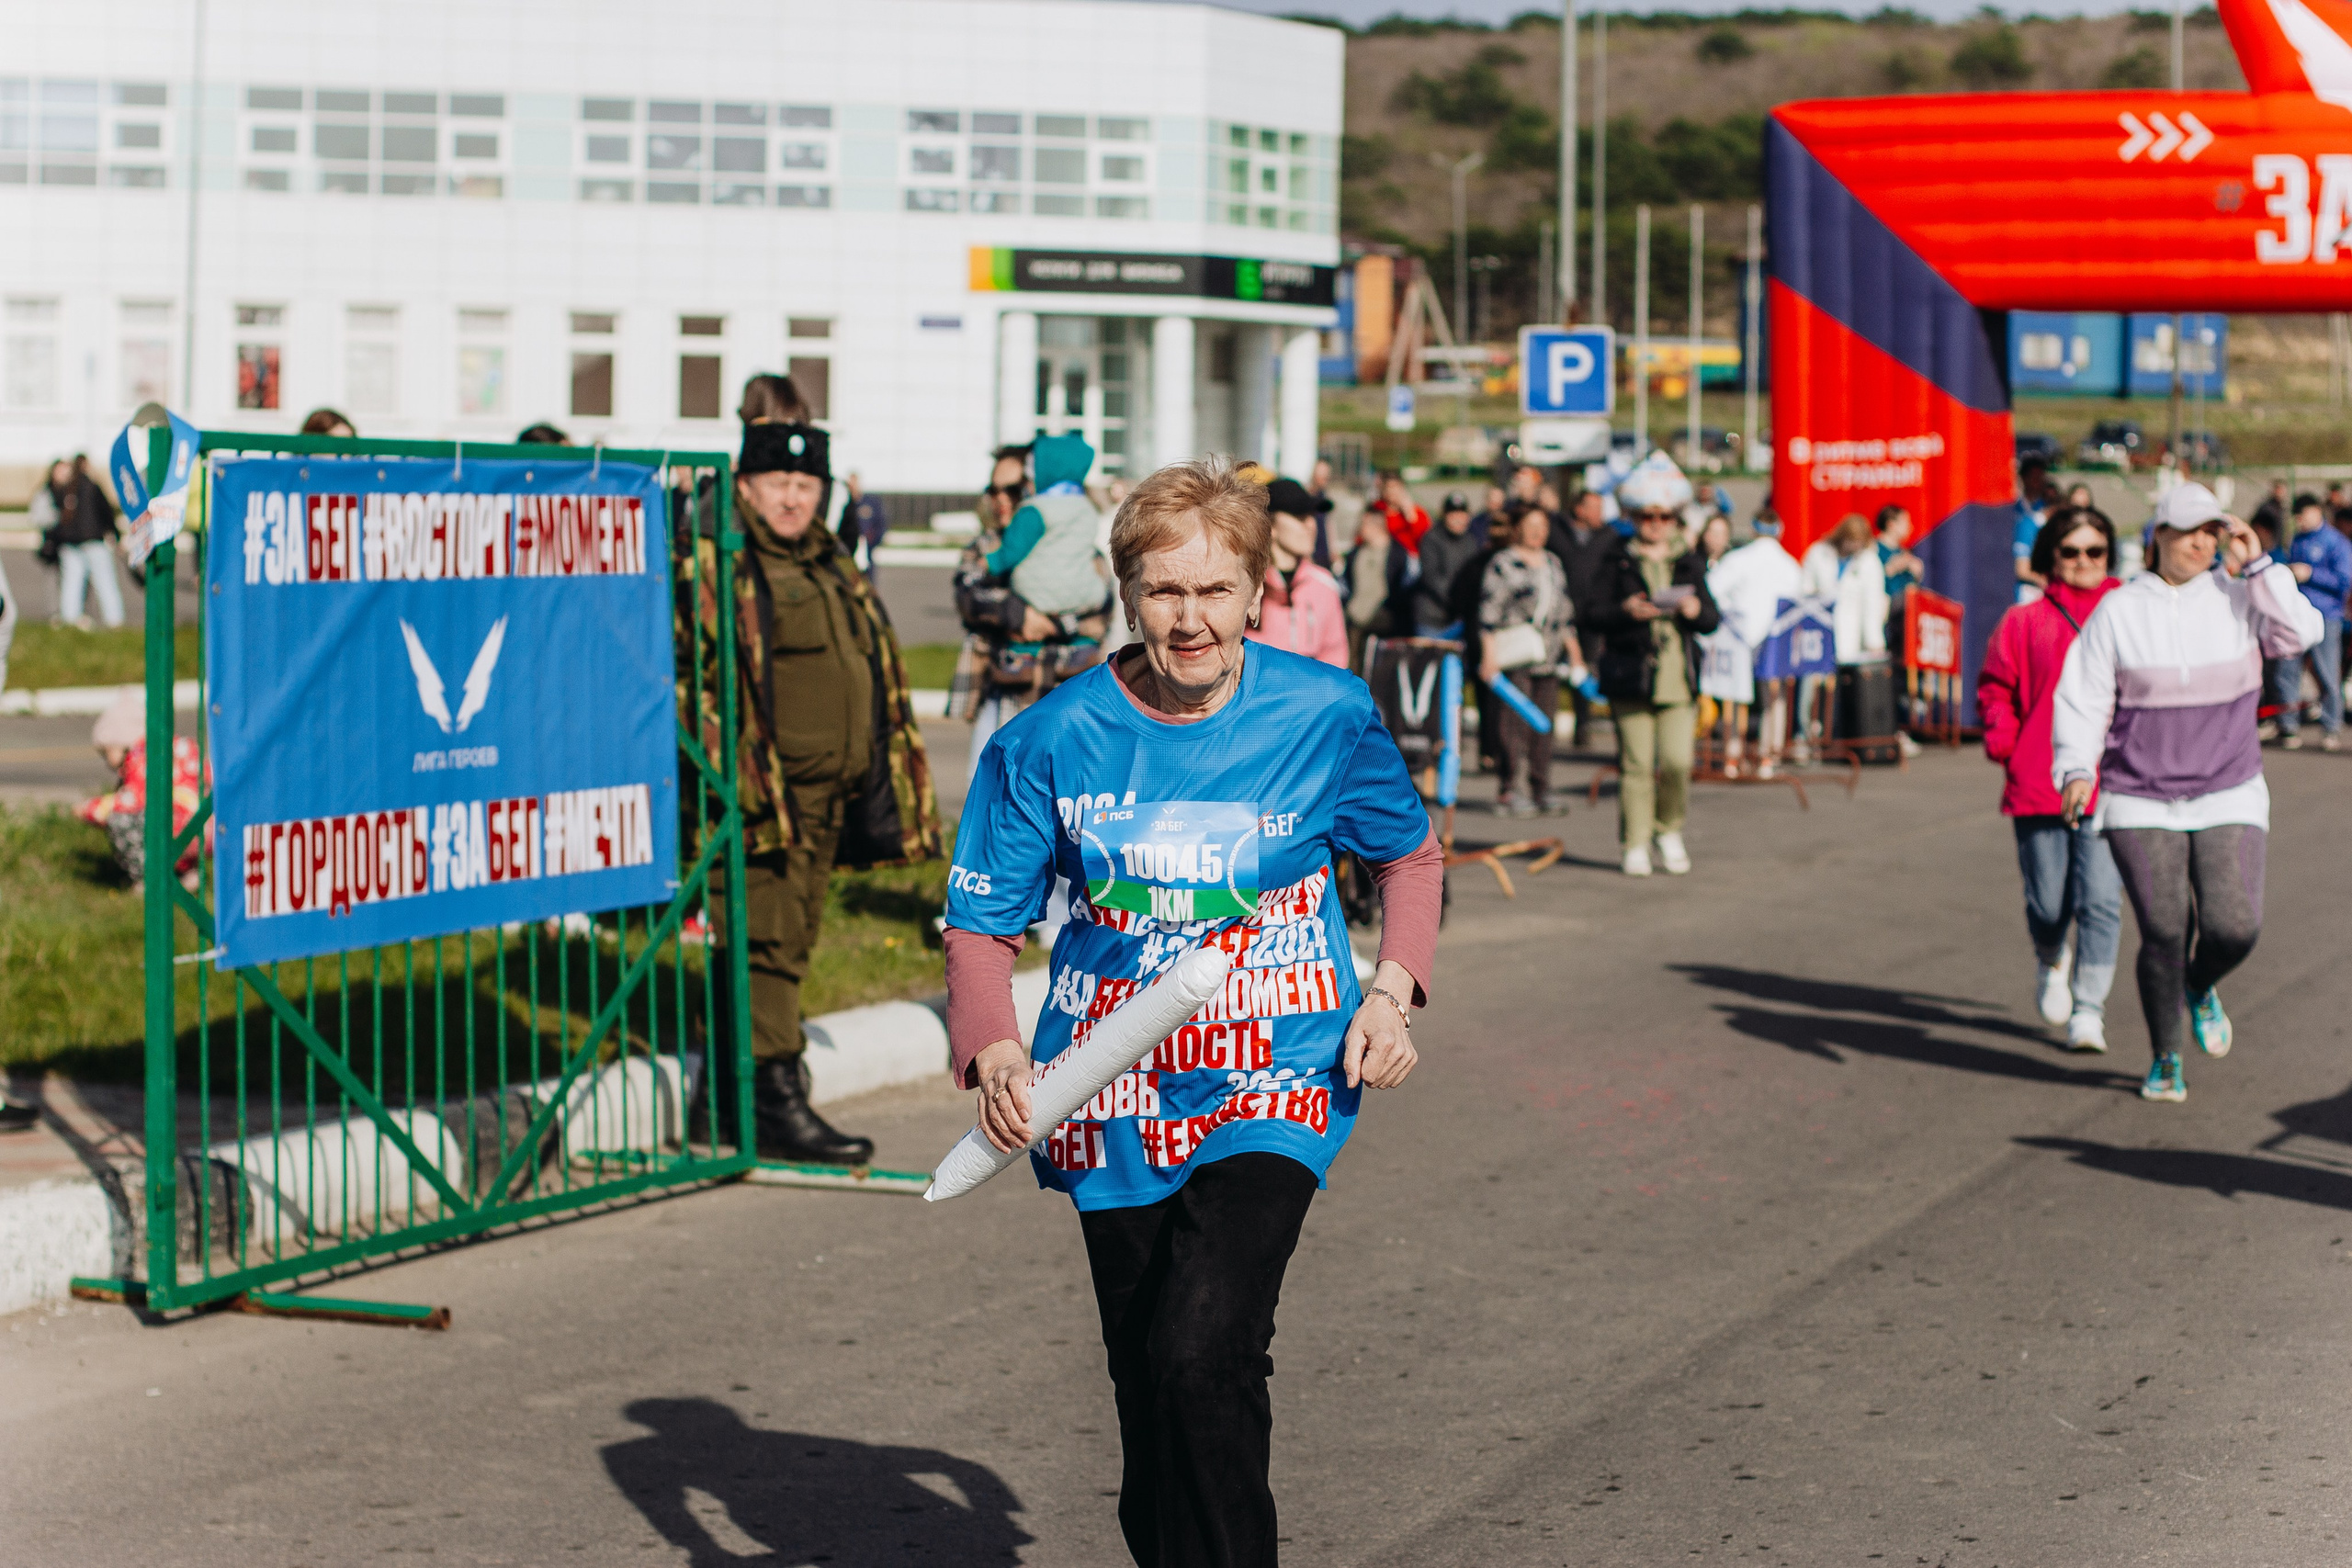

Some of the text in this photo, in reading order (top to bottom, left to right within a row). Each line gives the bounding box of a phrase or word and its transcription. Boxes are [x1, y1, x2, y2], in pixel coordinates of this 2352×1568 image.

[1548, 342, 1595, 406] P
[243, 491, 360, 584] #ЗАБЕГ
[363, 491, 513, 581] #ВОСТОРГ
[514, 495, 646, 576] #МОМЕНТ
[1057, 791, 1136, 844] 20
[1109, 810, 1135, 821] ПСБ
[244, 784, 653, 919] #ГОРДОСТЬ #ЗАБЕГ #МЕЧТА
[1120, 842, 1223, 884] 10045
[947, 864, 991, 896] ПСБ
